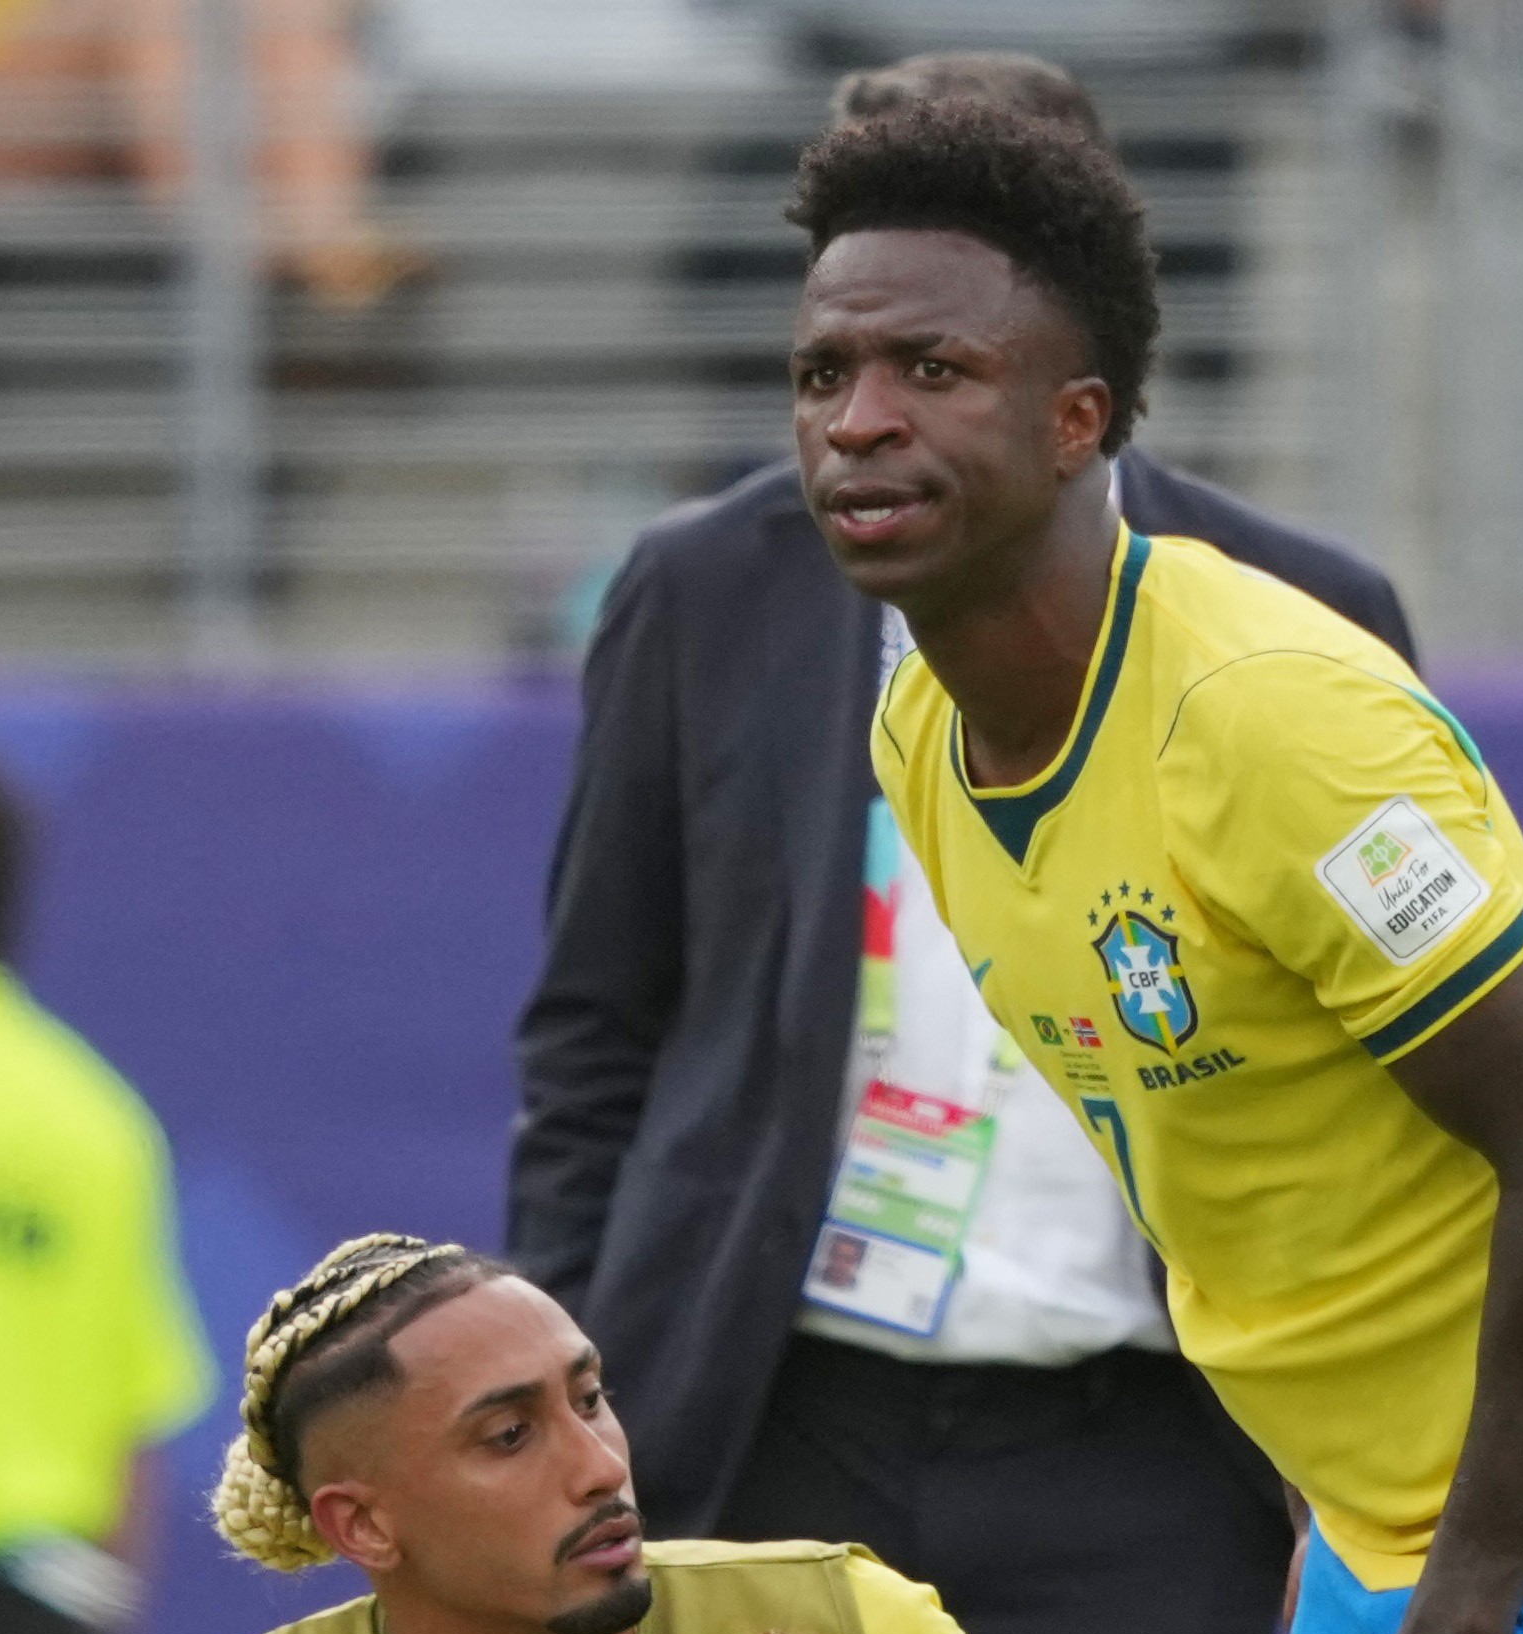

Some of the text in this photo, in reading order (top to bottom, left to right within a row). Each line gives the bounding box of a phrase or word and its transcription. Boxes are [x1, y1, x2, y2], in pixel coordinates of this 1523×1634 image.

[1378, 859, 1429, 911] Unite For
[1386, 868, 1457, 935] EDUCATION
[1421, 906, 1448, 931] FIFA
[1129, 970, 1160, 988] CBF
[1136, 1047, 1245, 1091] BRASIL
